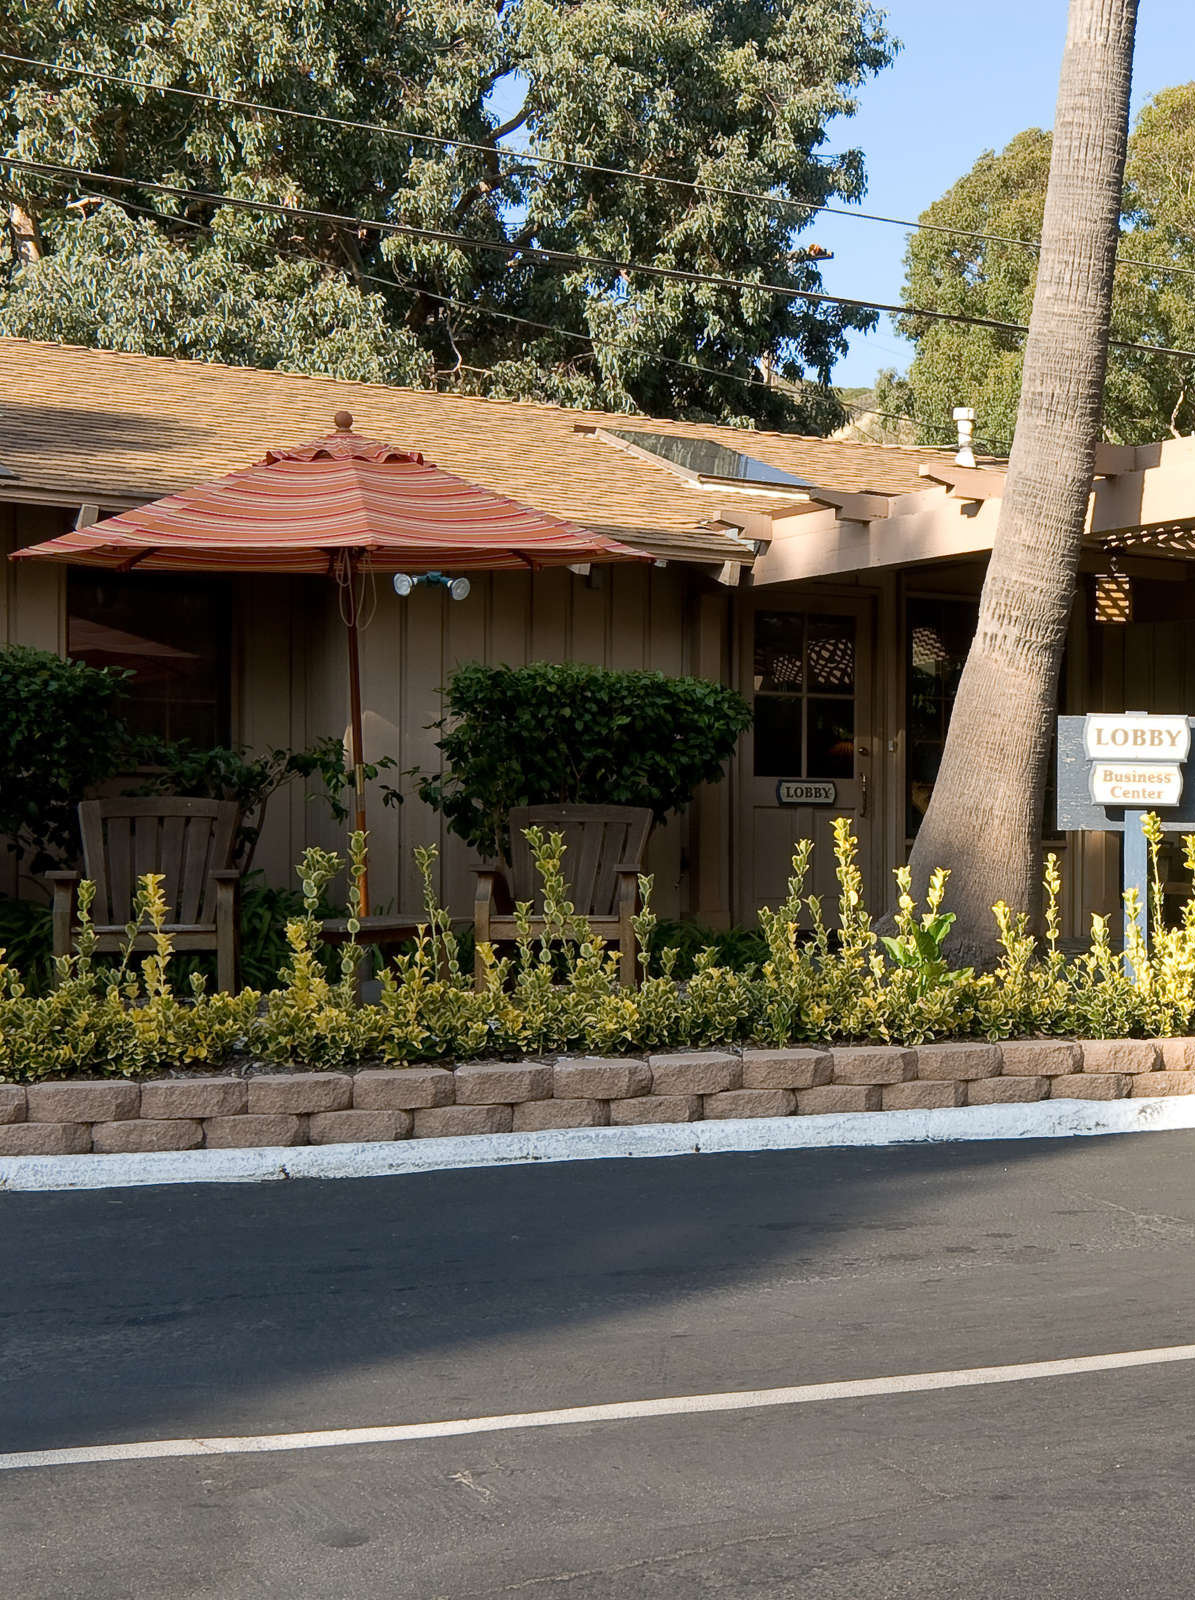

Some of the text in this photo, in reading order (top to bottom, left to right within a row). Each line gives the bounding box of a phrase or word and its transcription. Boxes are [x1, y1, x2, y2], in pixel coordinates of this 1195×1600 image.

[1095, 728, 1182, 747] LOBBY
[1103, 769, 1172, 784] Business
[785, 786, 831, 799] LOBBY
[1110, 785, 1164, 799] Center
